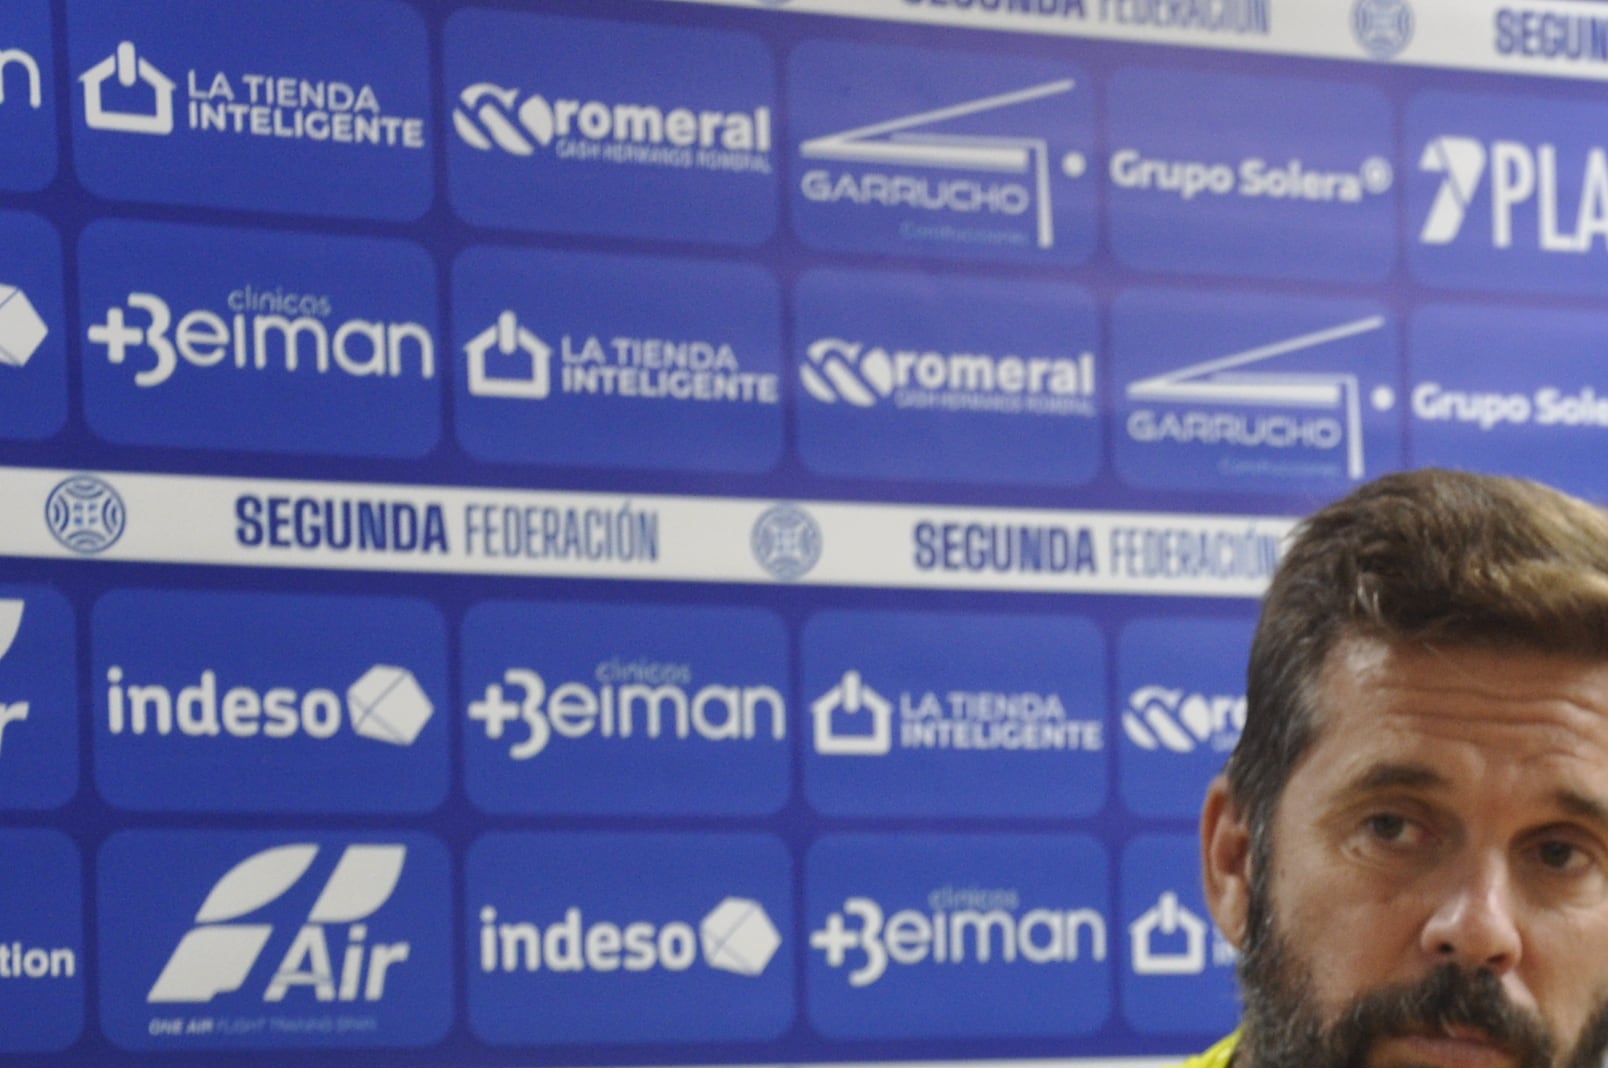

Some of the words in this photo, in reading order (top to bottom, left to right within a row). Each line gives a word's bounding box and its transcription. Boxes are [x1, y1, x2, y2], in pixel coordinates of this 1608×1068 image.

[188, 70, 234, 100] LA
[242, 75, 380, 114] TIENDA
[188, 102, 424, 148] INTELIGENTE
[554, 99, 771, 151] romeral
[802, 170, 1029, 215] GARRUCHO
[1110, 150, 1235, 198] Grupo
[562, 335, 606, 364] LA
[614, 337, 738, 371] TIENDA
[894, 352, 1095, 396] romeral
[561, 367, 778, 403] INTELIGENTE
[1411, 382, 1530, 430] Grupo
[1127, 409, 1342, 450] GARRUCHO
[235, 495, 449, 554] SEGUNDA
[464, 501, 659, 564] FEDERACIÓN
[913, 520, 1097, 574] SEGUNDA
[107, 667, 342, 738] indeso
[901, 692, 943, 719] LA
[947, 693, 1065, 721] TIENDA
[899, 720, 1101, 751] INTELIGENTE
[480, 907, 696, 973] indeso
[263, 925, 409, 1003] Air
